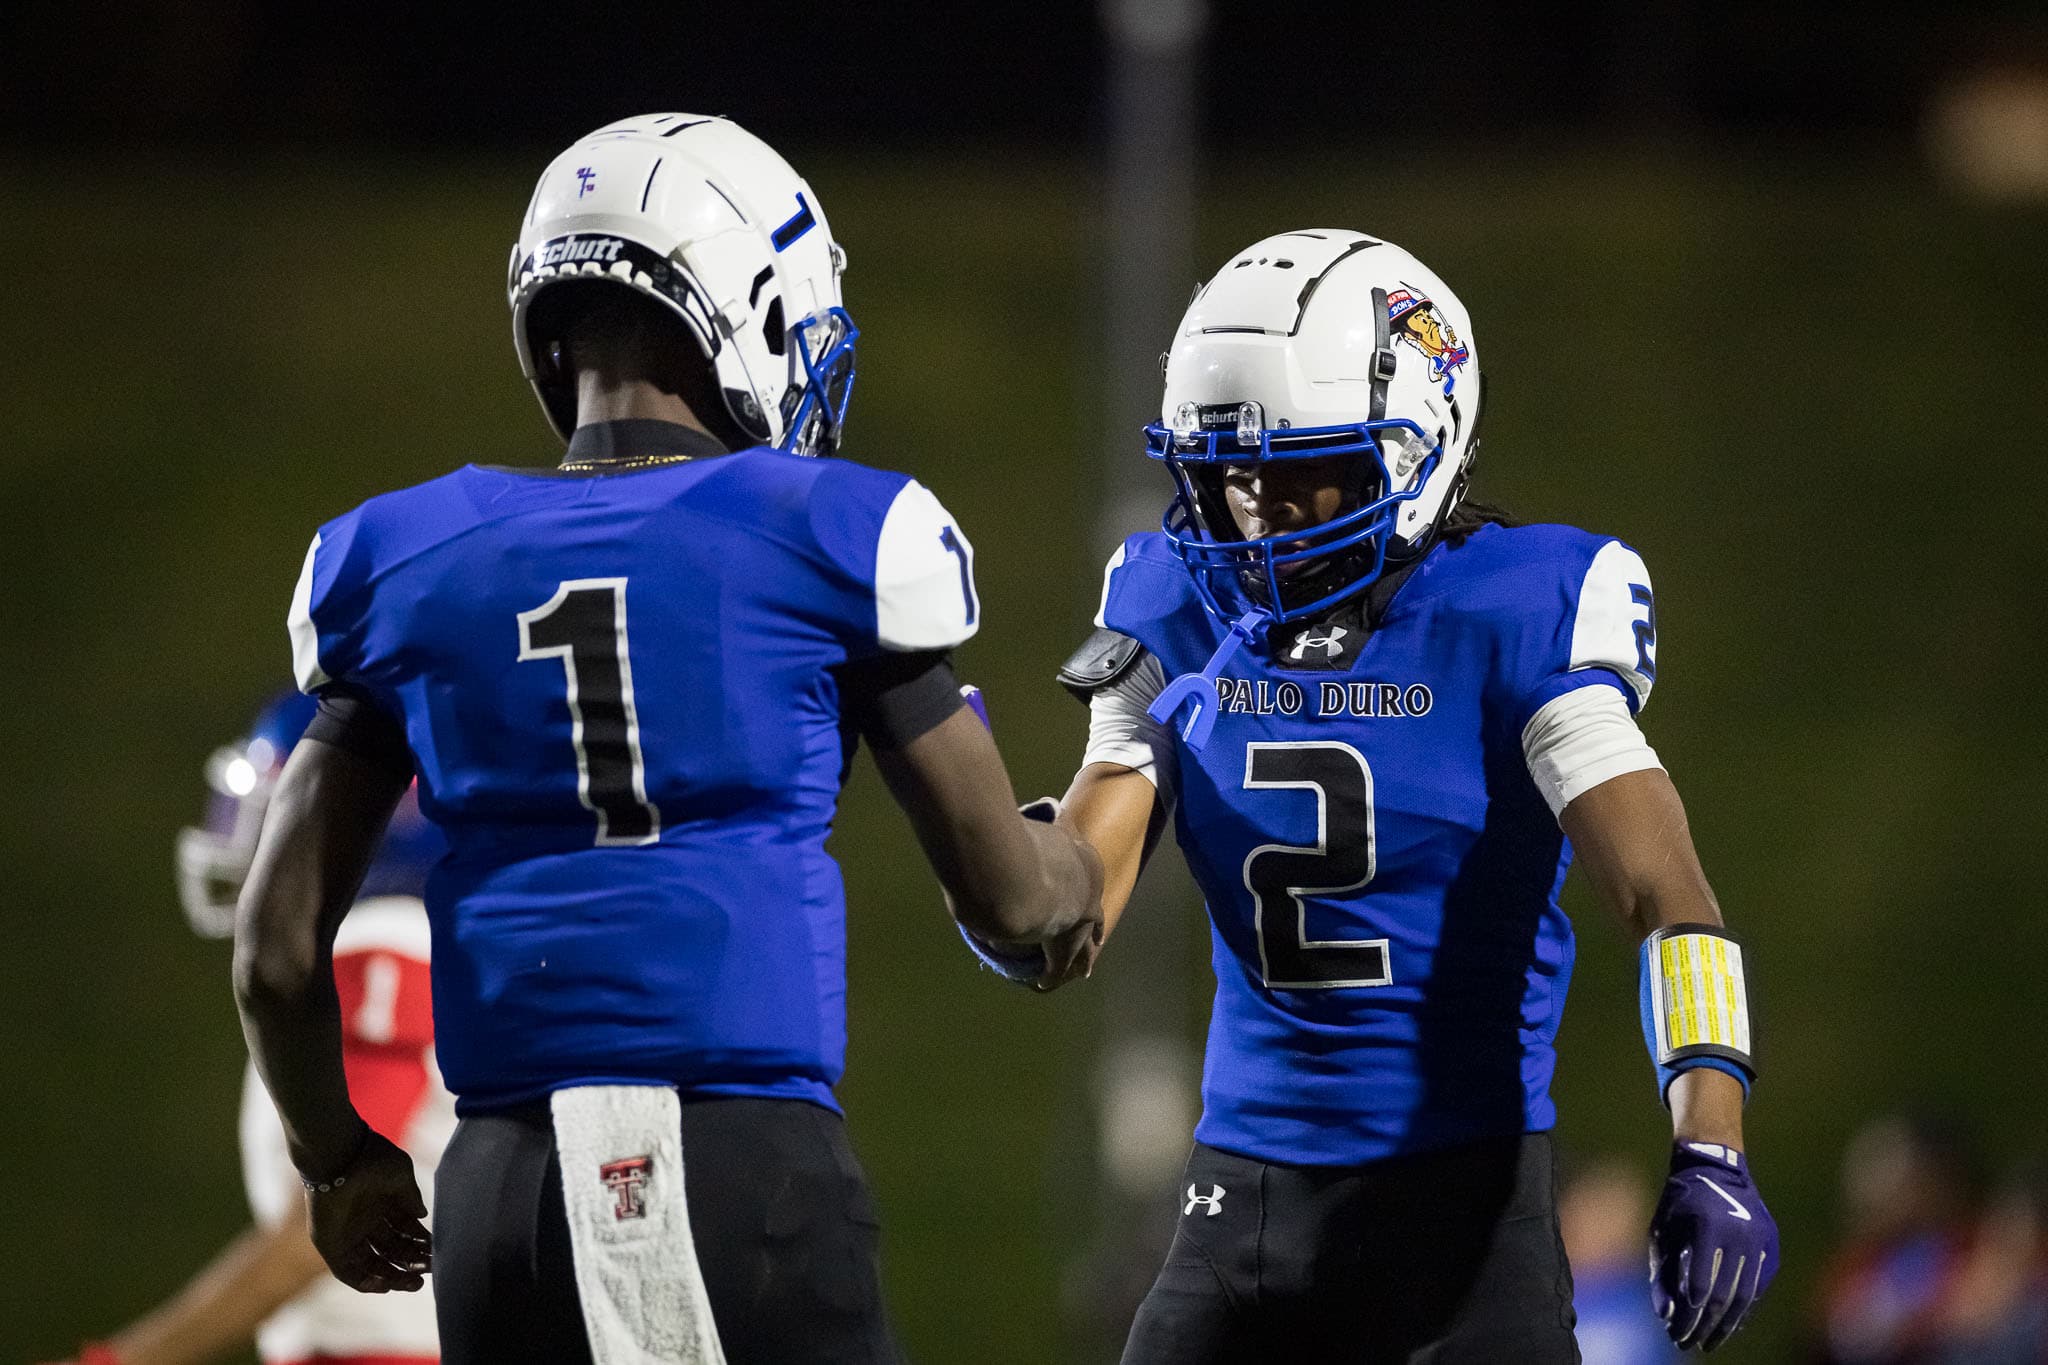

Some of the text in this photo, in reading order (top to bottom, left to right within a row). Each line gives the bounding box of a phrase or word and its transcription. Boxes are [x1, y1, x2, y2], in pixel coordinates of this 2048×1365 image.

[939, 525, 975, 626] 1
[1628, 582, 1657, 685] 2
[516, 577, 661, 847] 1
[1215, 677, 1434, 718] PALO DURO
[1243, 740, 1394, 989] 2
